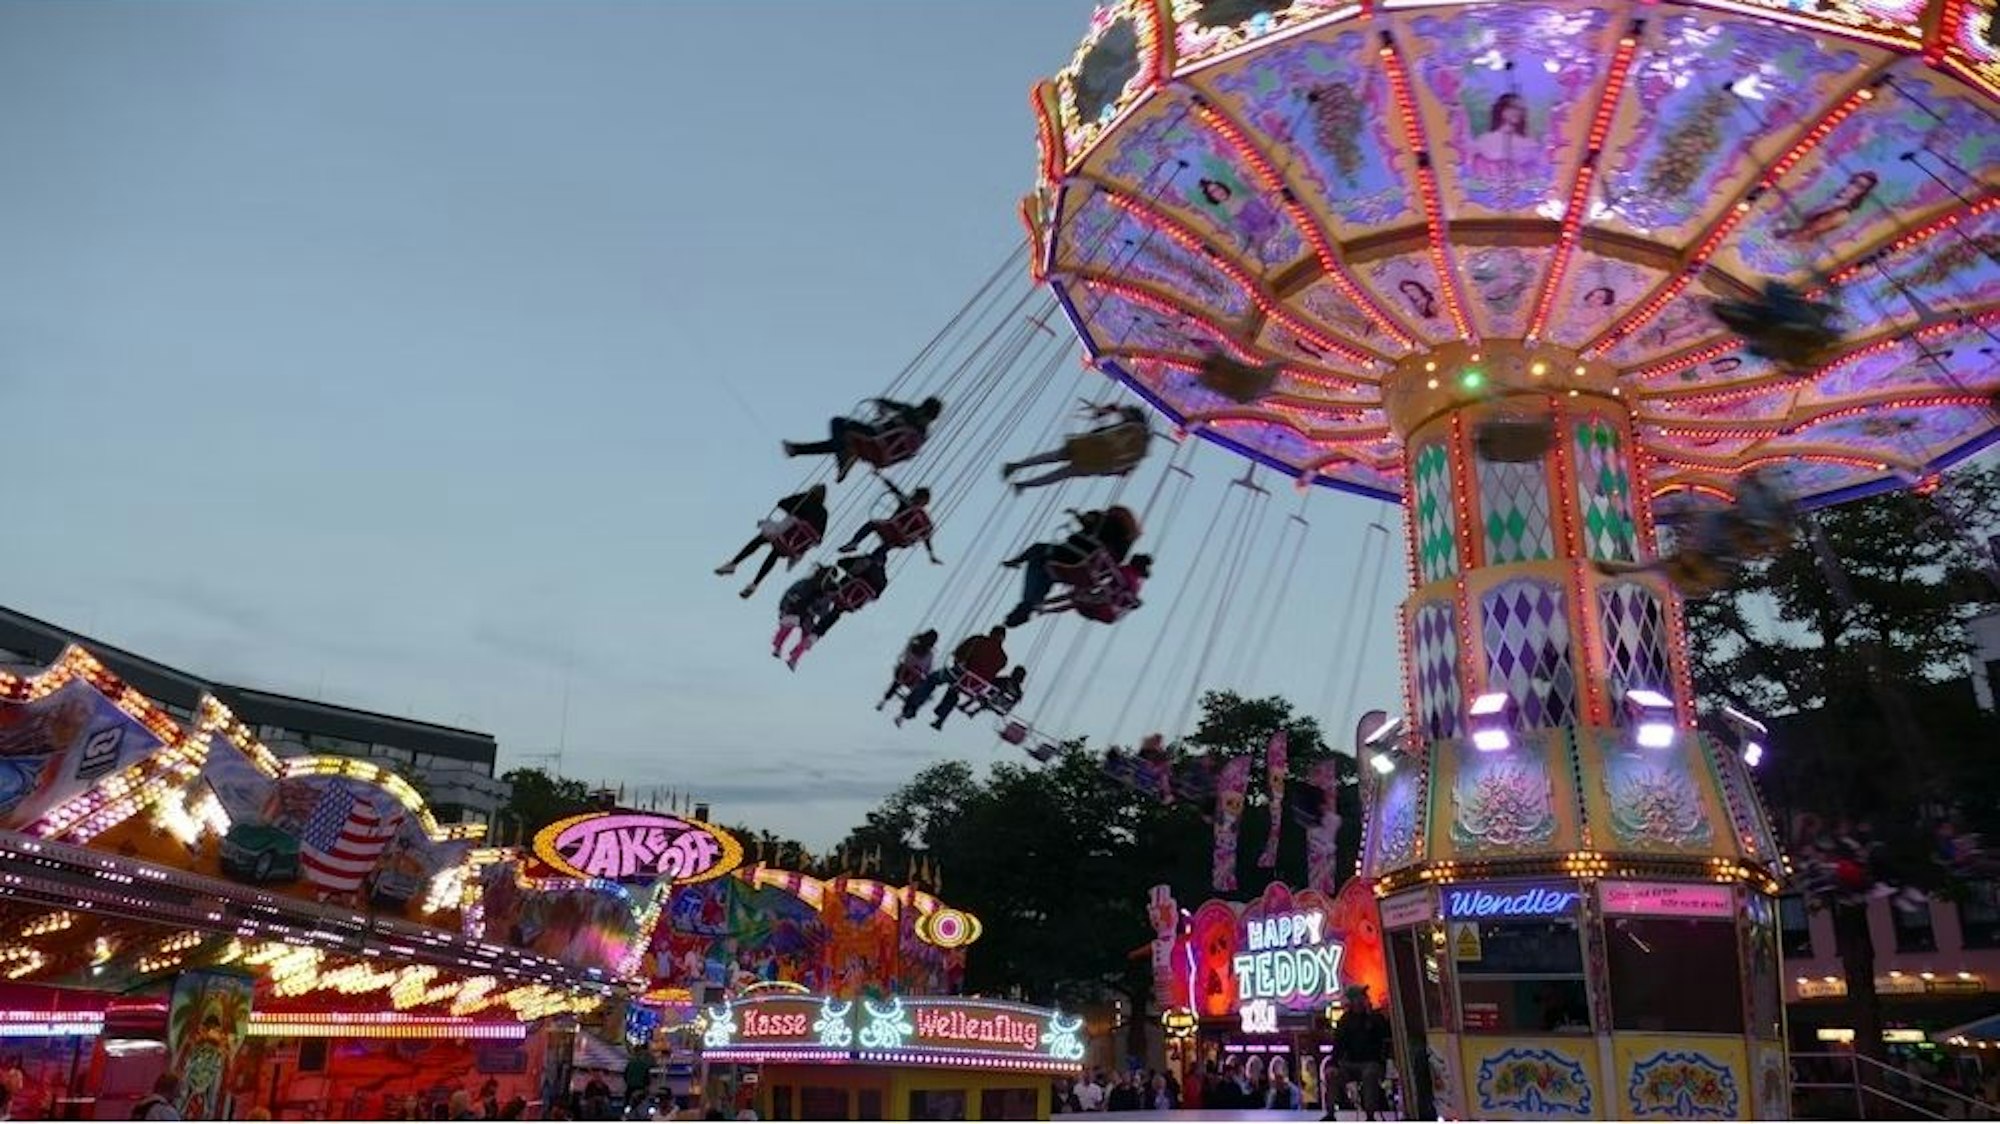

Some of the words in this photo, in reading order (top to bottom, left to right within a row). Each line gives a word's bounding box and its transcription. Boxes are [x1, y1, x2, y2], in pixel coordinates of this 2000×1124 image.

[556, 814, 690, 876] TAKE
[657, 830, 719, 878] OFF
[1451, 888, 1580, 915] Wendler
[1247, 911, 1322, 951] HAPPY
[1233, 944, 1343, 1000] TEDDY
[743, 1010, 807, 1037] Kasse
[917, 1008, 1038, 1049] Wellenflug
